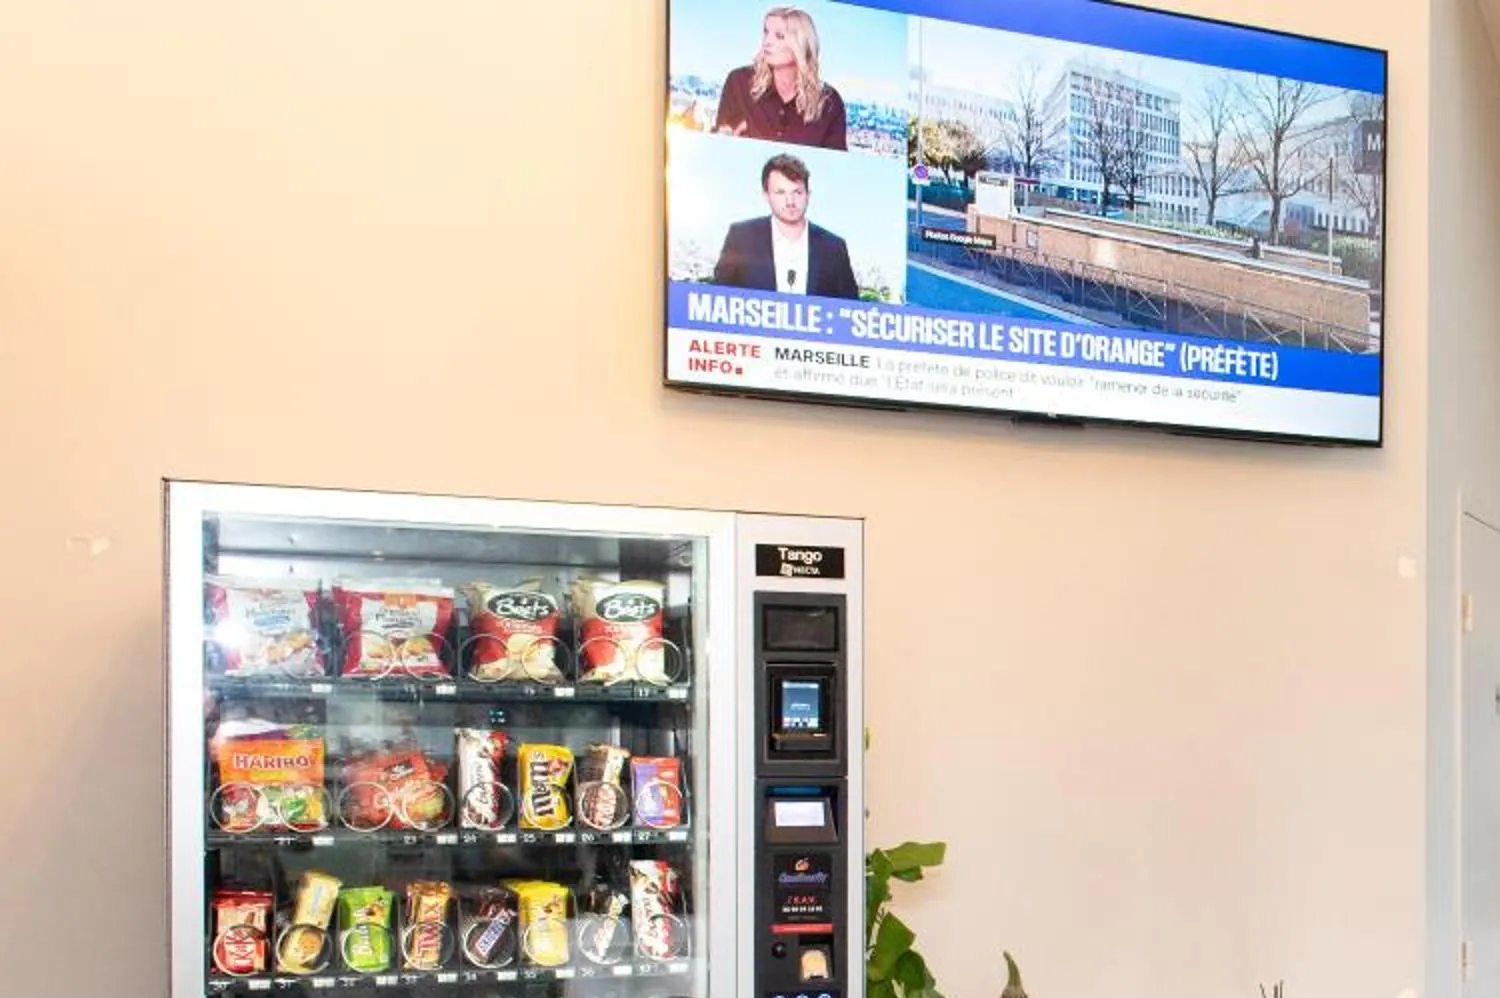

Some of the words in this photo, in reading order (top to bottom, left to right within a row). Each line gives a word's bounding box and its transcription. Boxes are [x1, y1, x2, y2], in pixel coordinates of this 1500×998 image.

[687, 291, 821, 334] MARSEILLE
[839, 306, 975, 349] "SÉCURISER
[979, 321, 1003, 351] LE
[1008, 325, 1057, 357] SITE
[1061, 331, 1175, 368] D'ORANGE"
[1180, 340, 1280, 381] (PRÉFÈTE)
[688, 339, 761, 359] ALERTE
[774, 347, 872, 369] MARSEILLE
[777, 546, 823, 565] Tango
[231, 751, 312, 770] HARIBO
